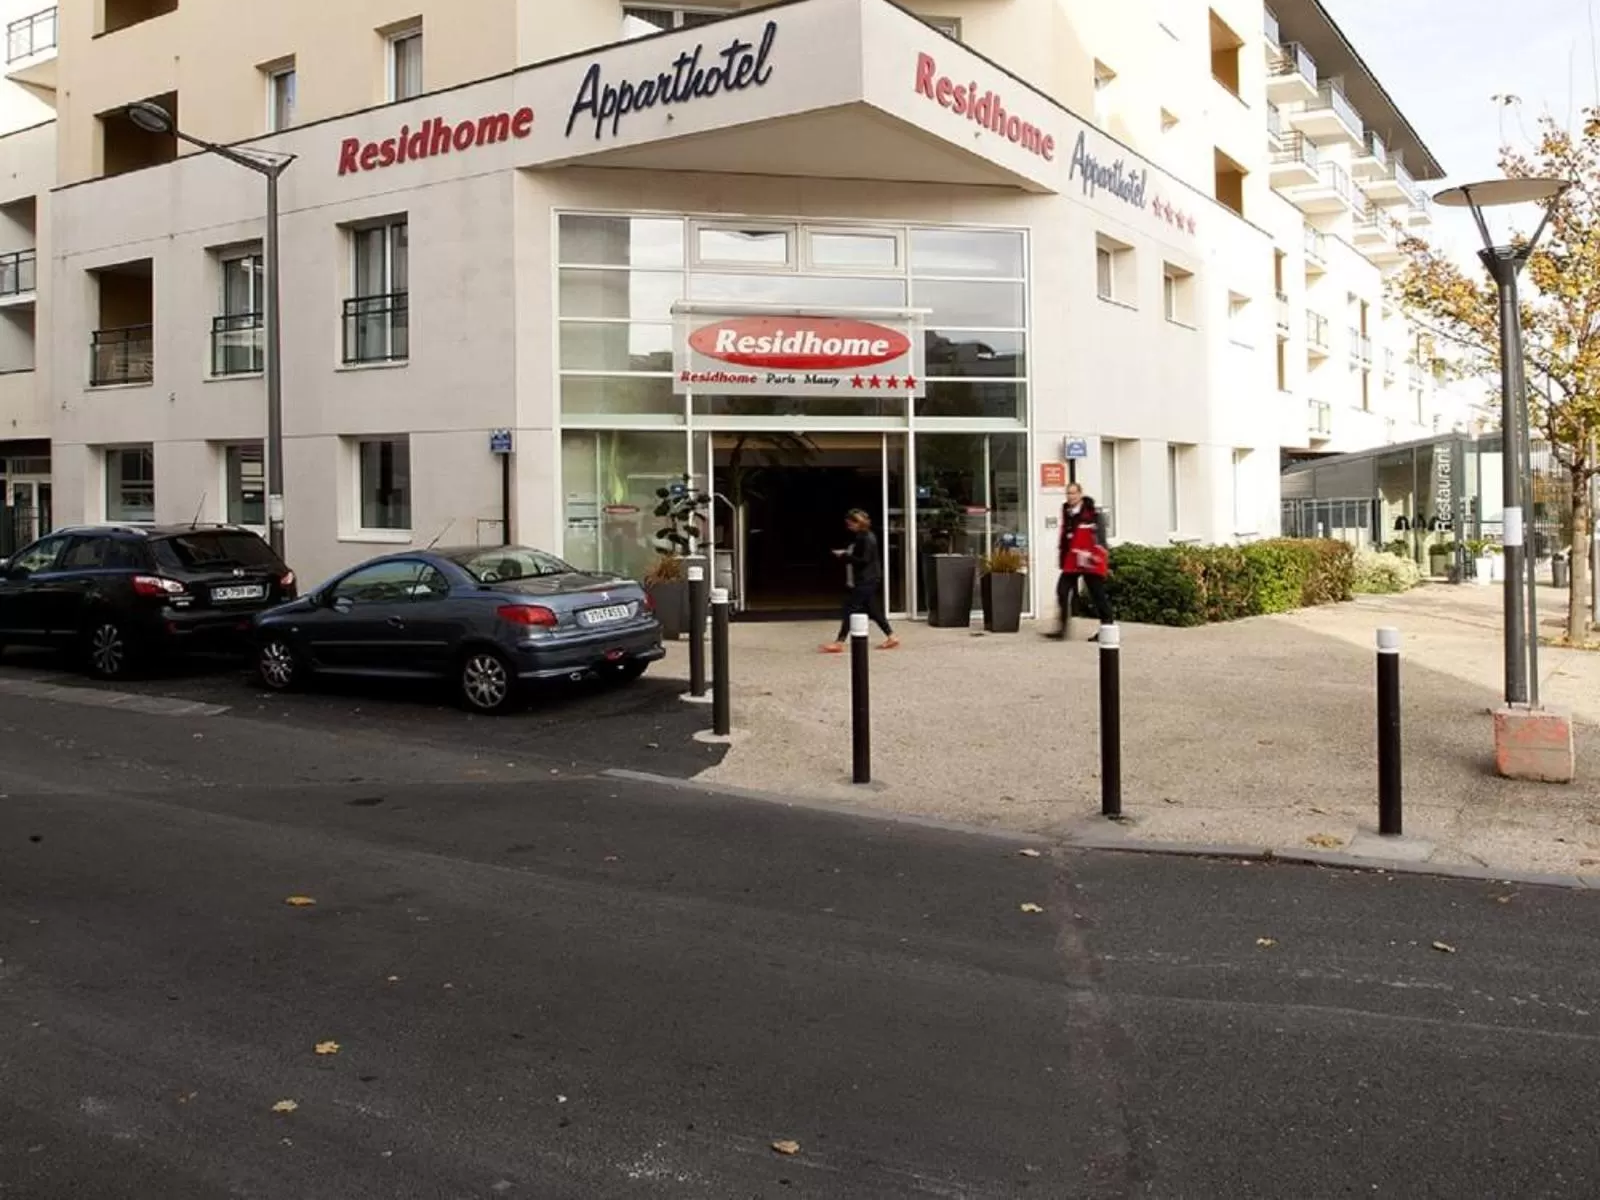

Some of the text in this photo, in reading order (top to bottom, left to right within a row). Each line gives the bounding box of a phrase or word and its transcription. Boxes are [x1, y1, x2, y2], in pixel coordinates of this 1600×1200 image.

[337, 106, 535, 177] Residhome
[913, 51, 1056, 162] Residhome
[680, 370, 758, 384] Residhome
[714, 328, 890, 357] Residhome
[1434, 446, 1453, 534] Restaurant
